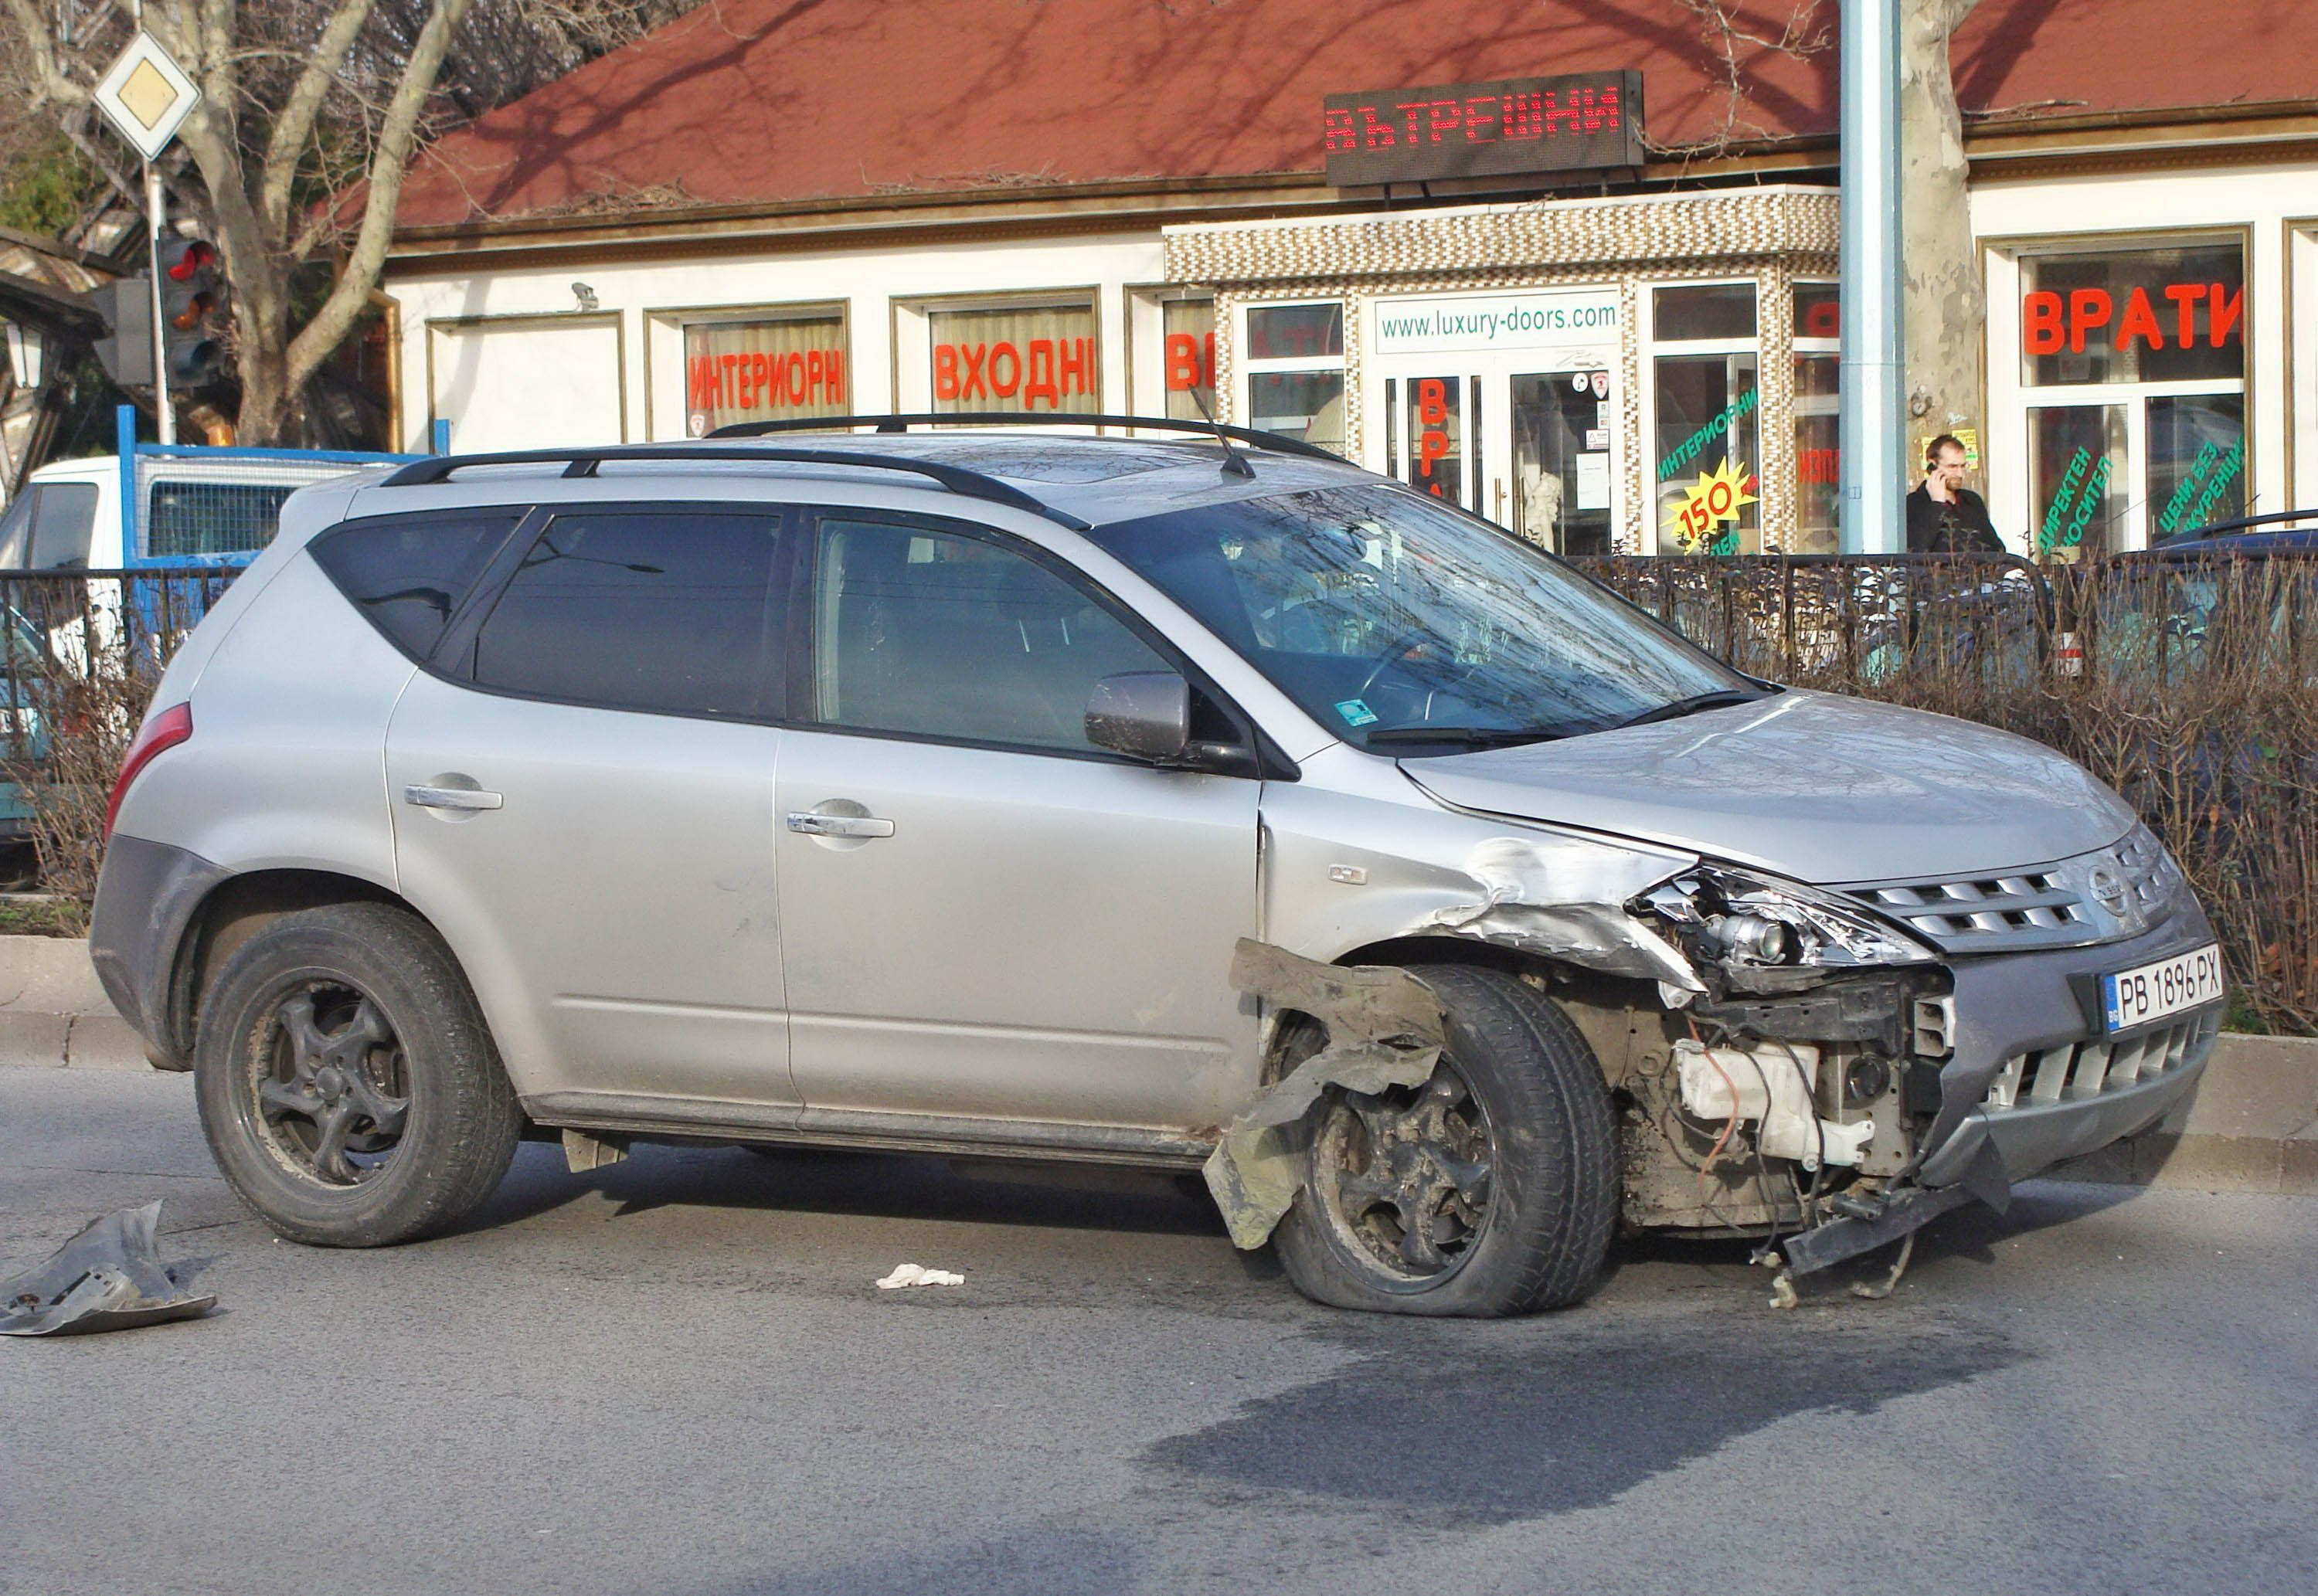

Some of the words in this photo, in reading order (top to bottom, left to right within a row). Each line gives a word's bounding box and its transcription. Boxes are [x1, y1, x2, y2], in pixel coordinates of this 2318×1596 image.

[1325, 86, 1619, 152] ВЪТРЕШНИ
[1382, 305, 1616, 340] www.luxury-doors.com
[1419, 379, 1450, 497] ВР
[1657, 386, 1759, 482] ИНТЕРИОРНИ
[1680, 481, 1732, 539] 150
[2037, 445, 2092, 555] ДИРЕКТЕН
[2158, 476, 2196, 533] ЦЕНИ
[2108, 1010, 2119, 1023] BG
[2120, 974, 2148, 1020] PB
[2154, 959, 2195, 1010] 1896
[2197, 950, 2219, 997] PX
